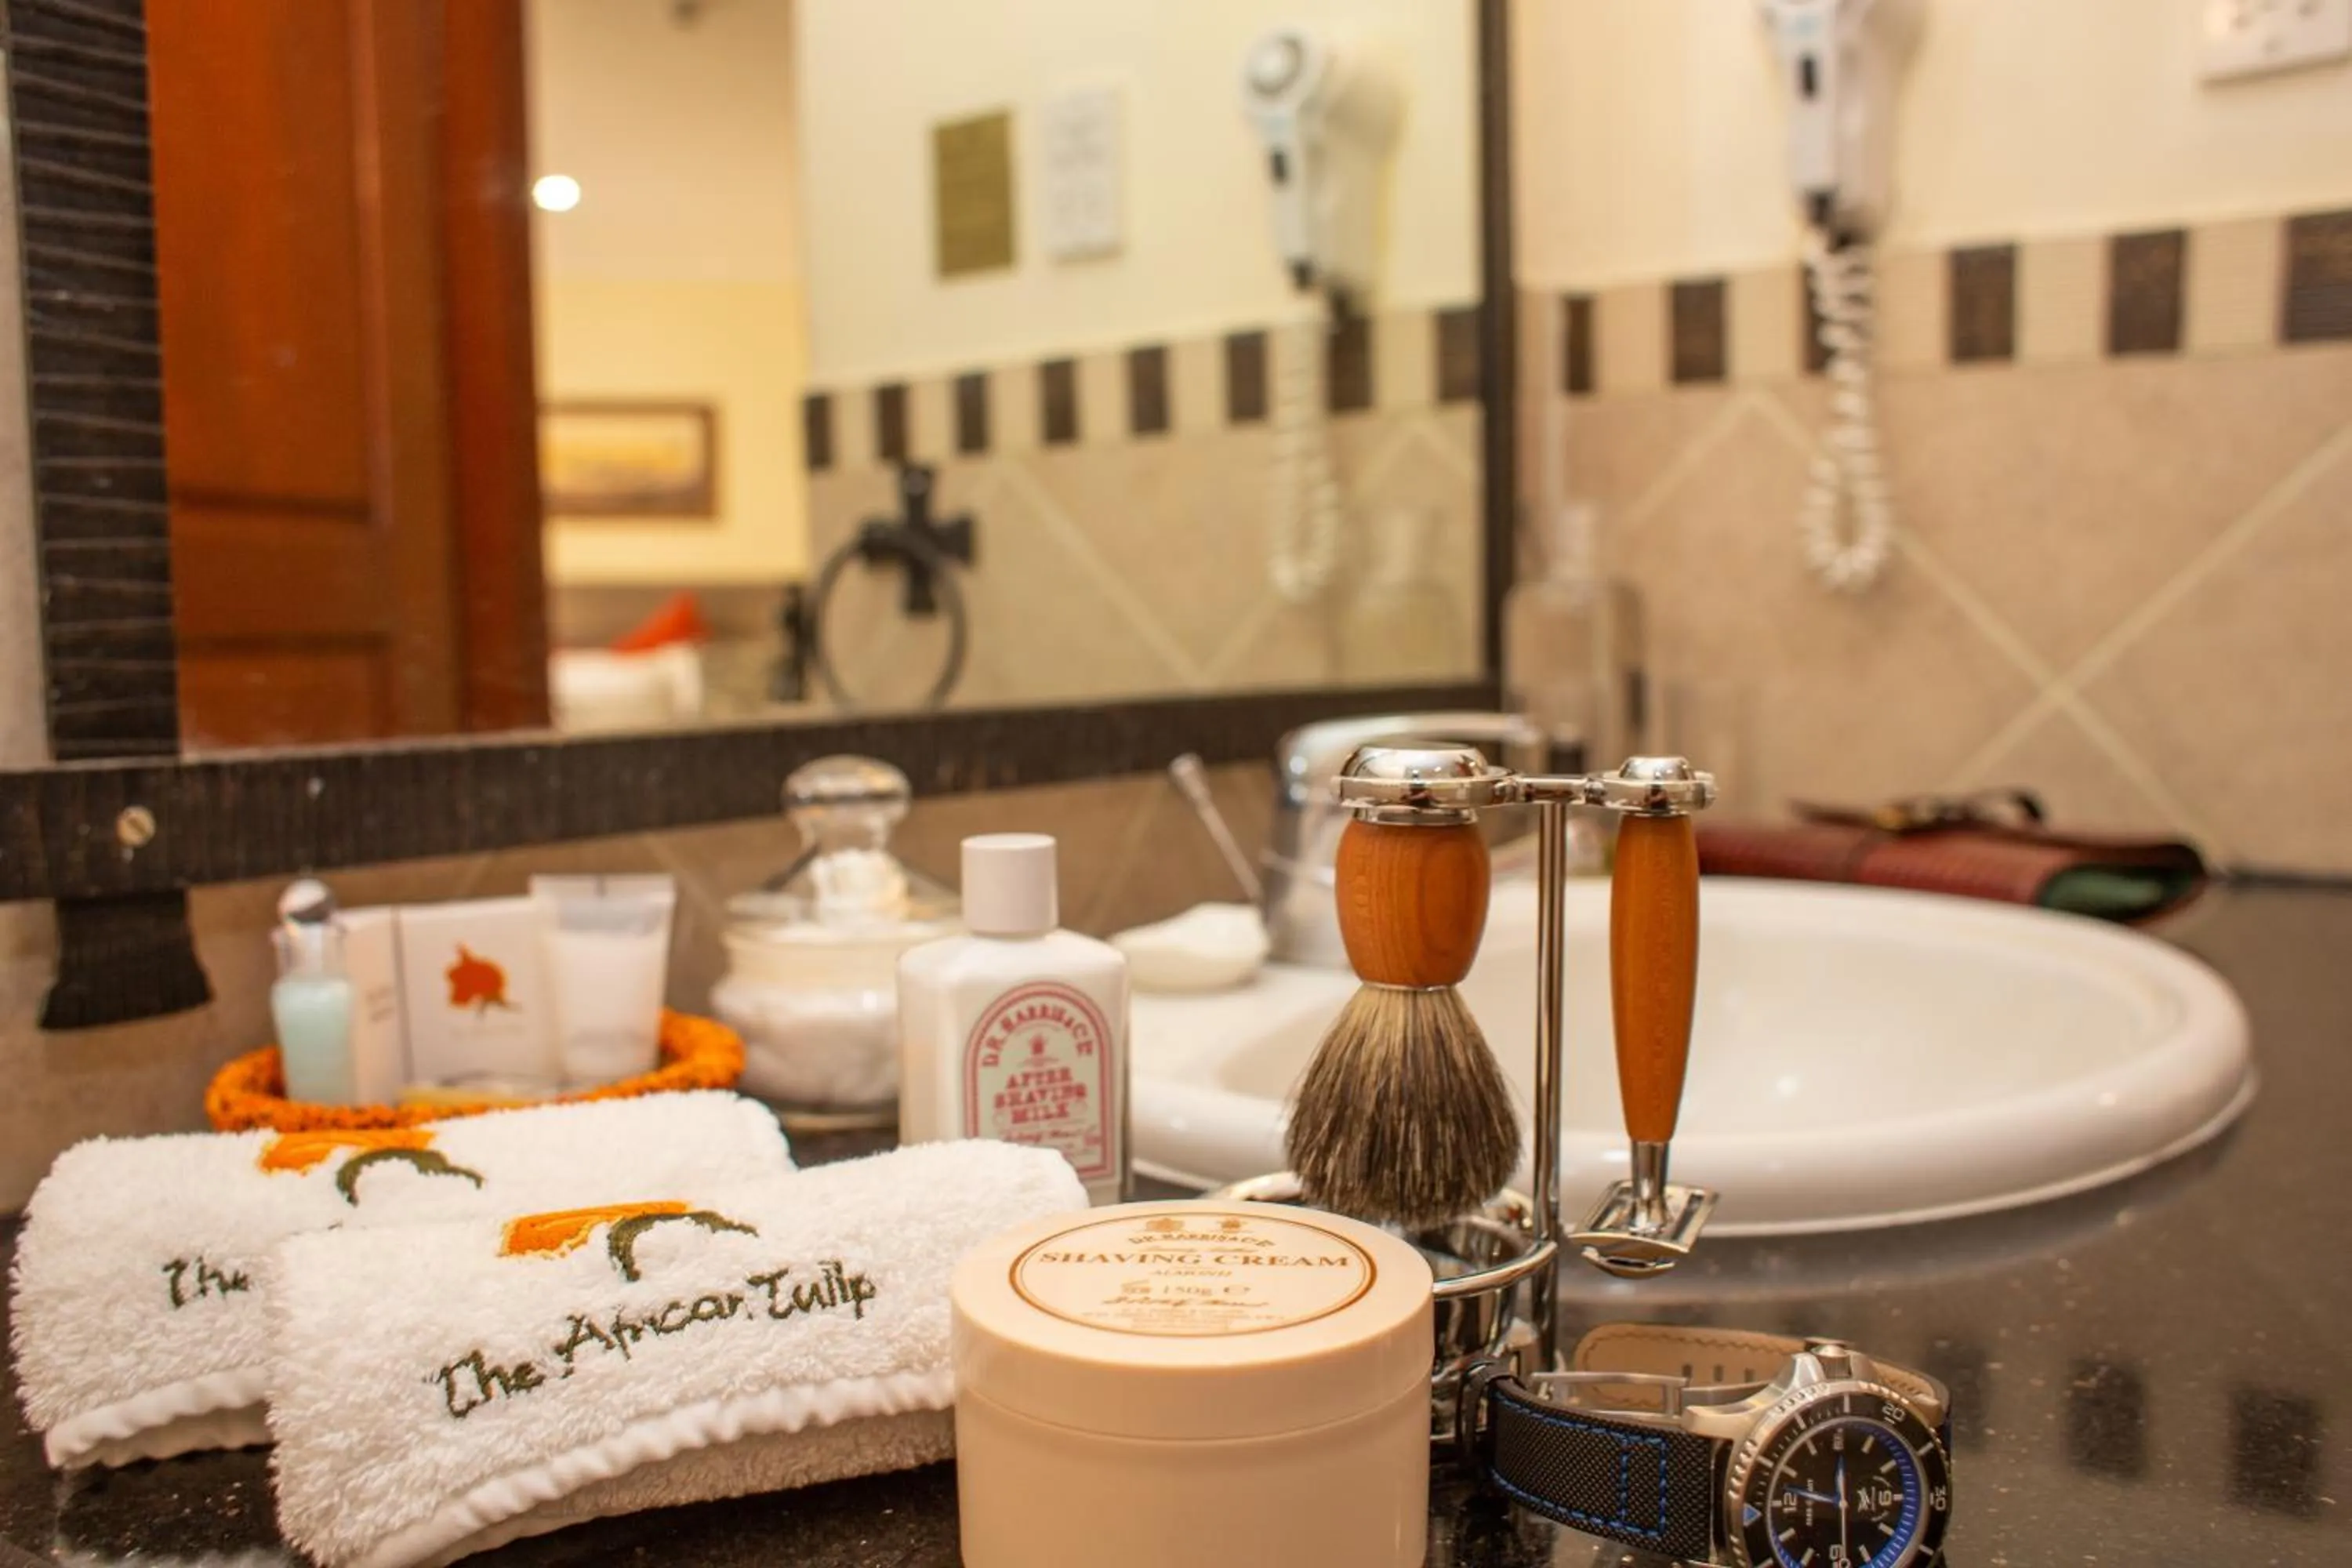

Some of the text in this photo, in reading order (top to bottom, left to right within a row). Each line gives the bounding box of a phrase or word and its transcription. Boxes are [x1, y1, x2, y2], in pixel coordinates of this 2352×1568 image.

[1038, 1252, 1350, 1269] SHAVING CREAM
[434, 1349, 546, 1418] The
[746, 1258, 878, 1320] Tulip
[1882, 1401, 1906, 1423] 20
[1783, 1492, 1798, 1513] 12
[1878, 1490, 1893, 1506] 6
